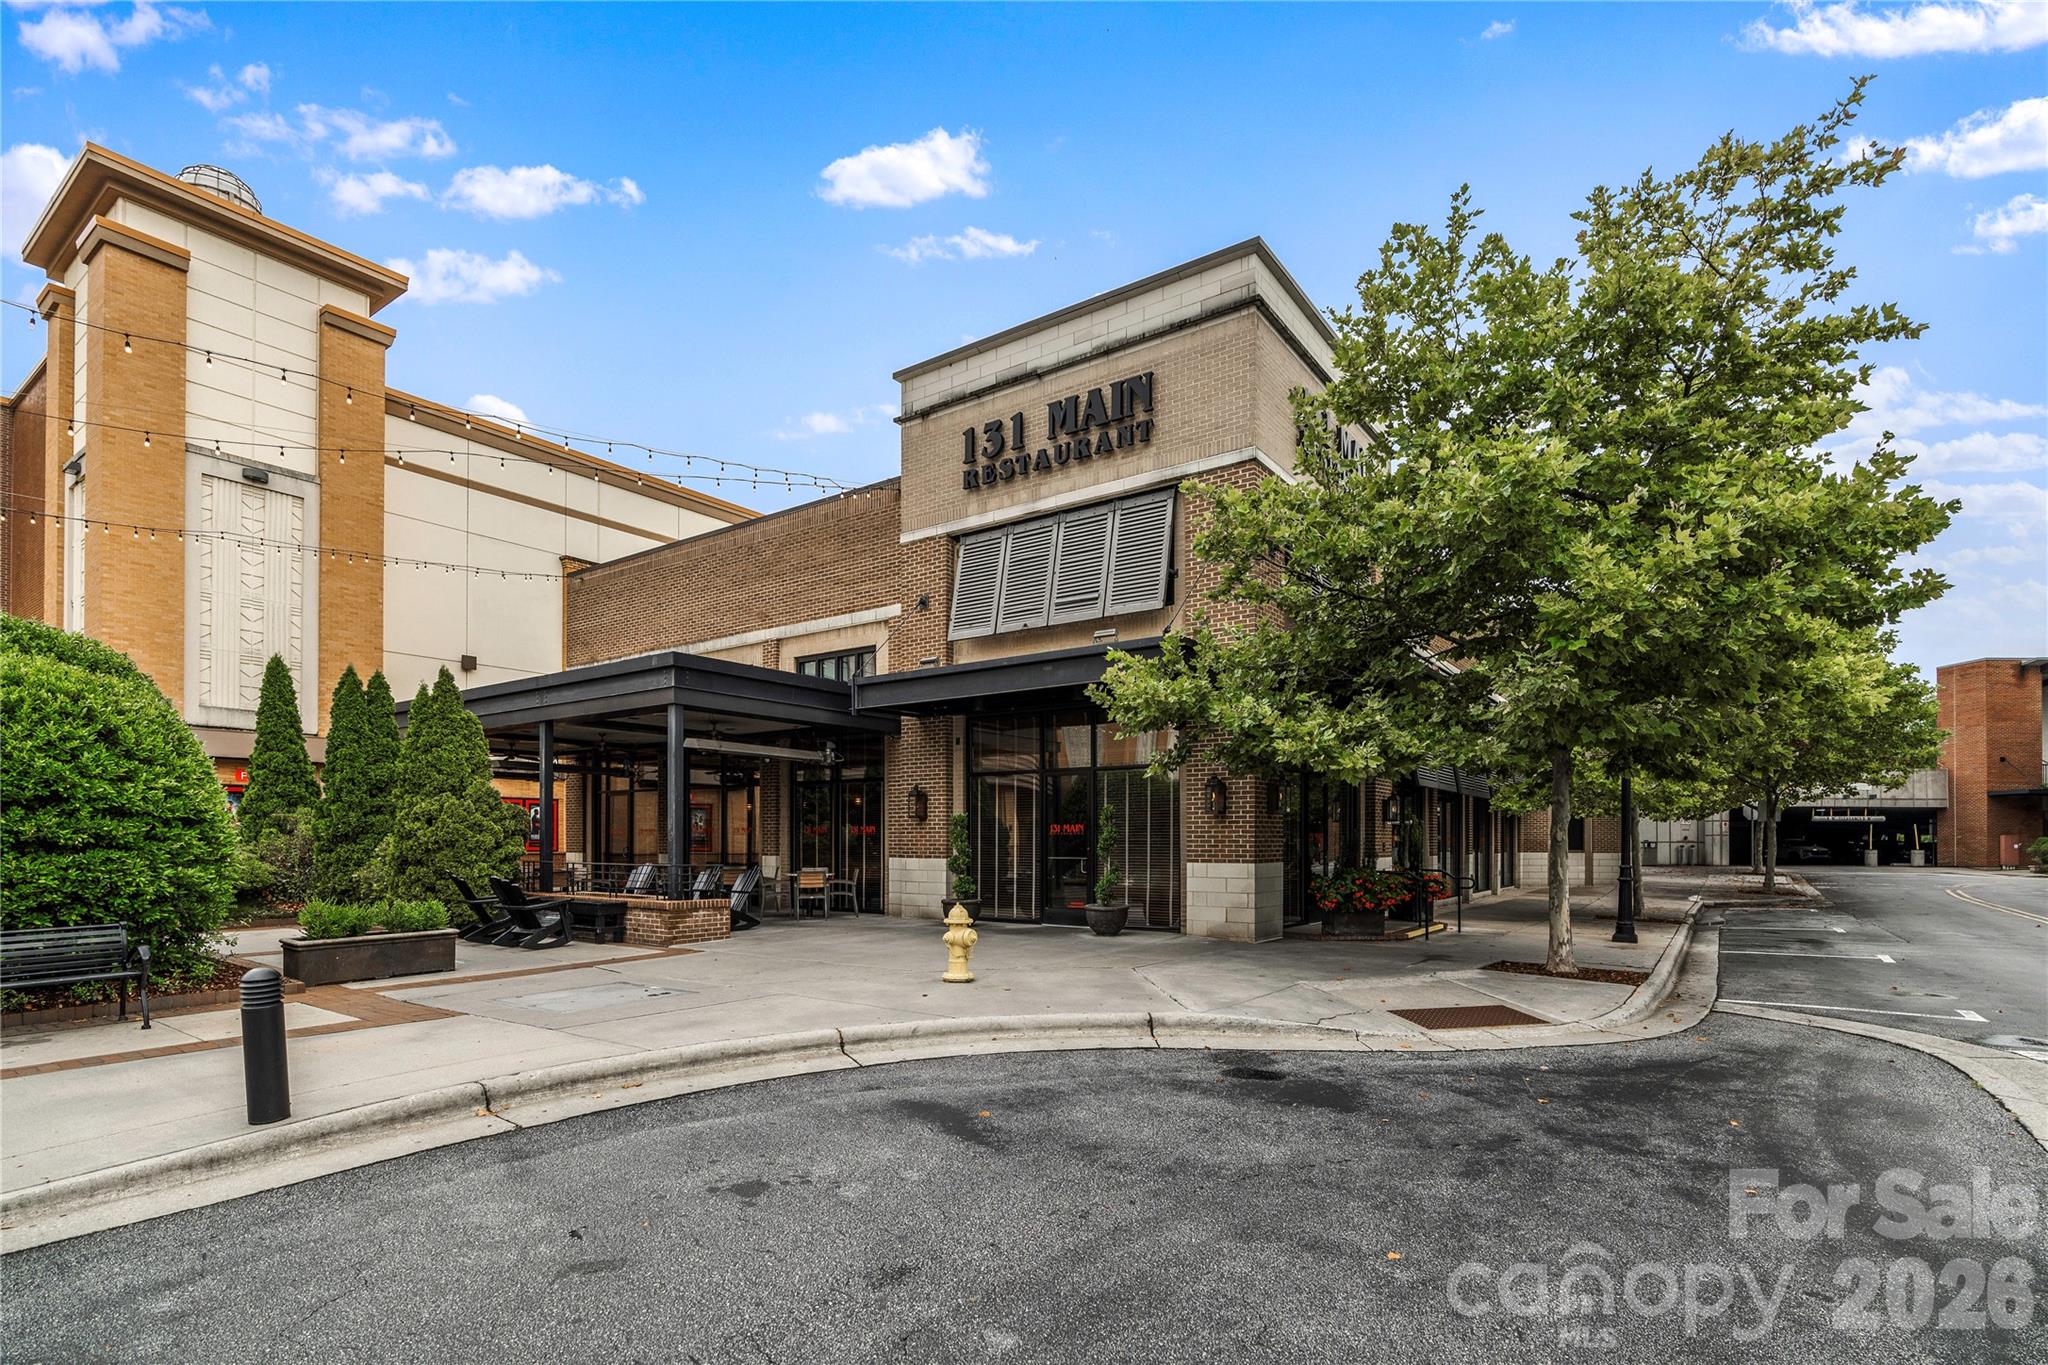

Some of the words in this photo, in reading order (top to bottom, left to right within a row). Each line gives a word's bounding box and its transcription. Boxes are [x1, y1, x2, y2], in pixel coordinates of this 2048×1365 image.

[962, 418, 1155, 490] RESTAURANT
[963, 411, 1025, 465] 131
[1047, 371, 1155, 440] MAIN
